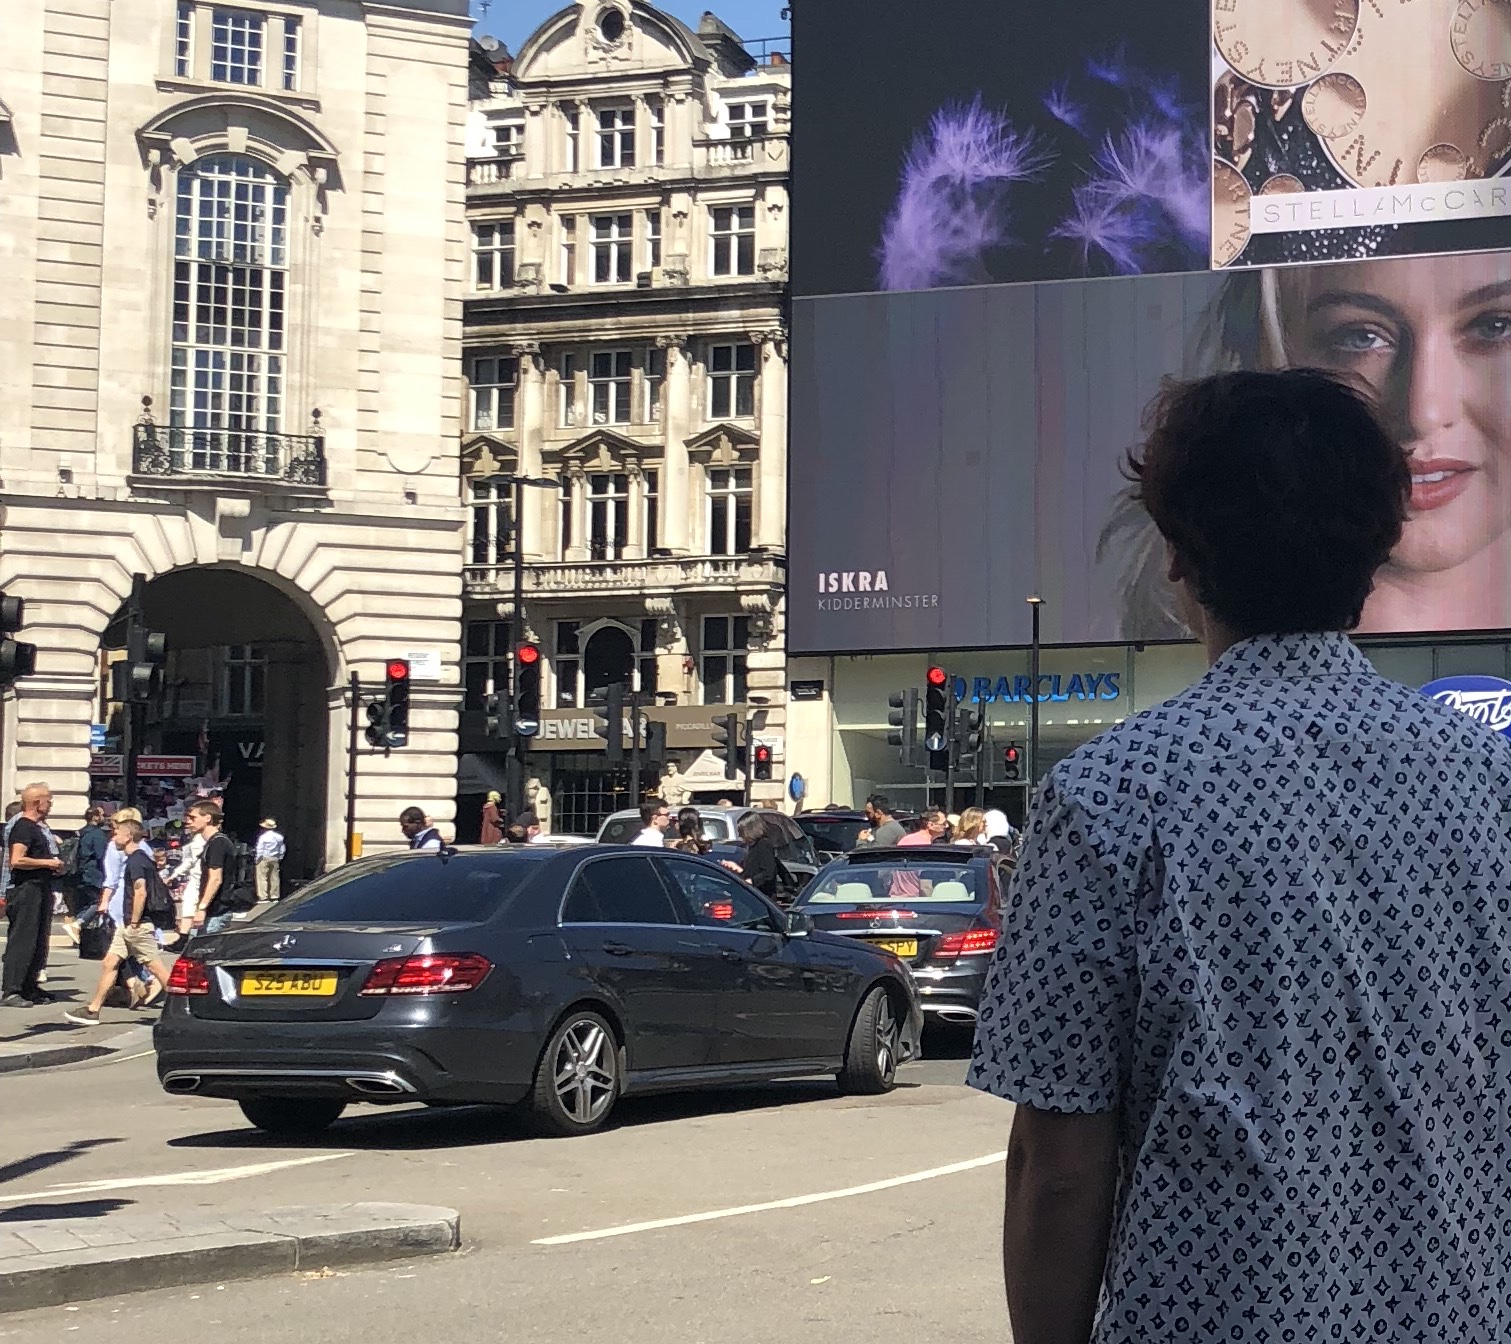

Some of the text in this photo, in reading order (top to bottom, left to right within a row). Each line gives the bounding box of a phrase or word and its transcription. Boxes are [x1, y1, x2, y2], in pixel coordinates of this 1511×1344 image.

[818, 570, 889, 594] ISKRA
[817, 593, 940, 611] KIDDERMINSTER
[972, 672, 1120, 704] BARCLAYS
[535, 718, 600, 740] JEWEL
